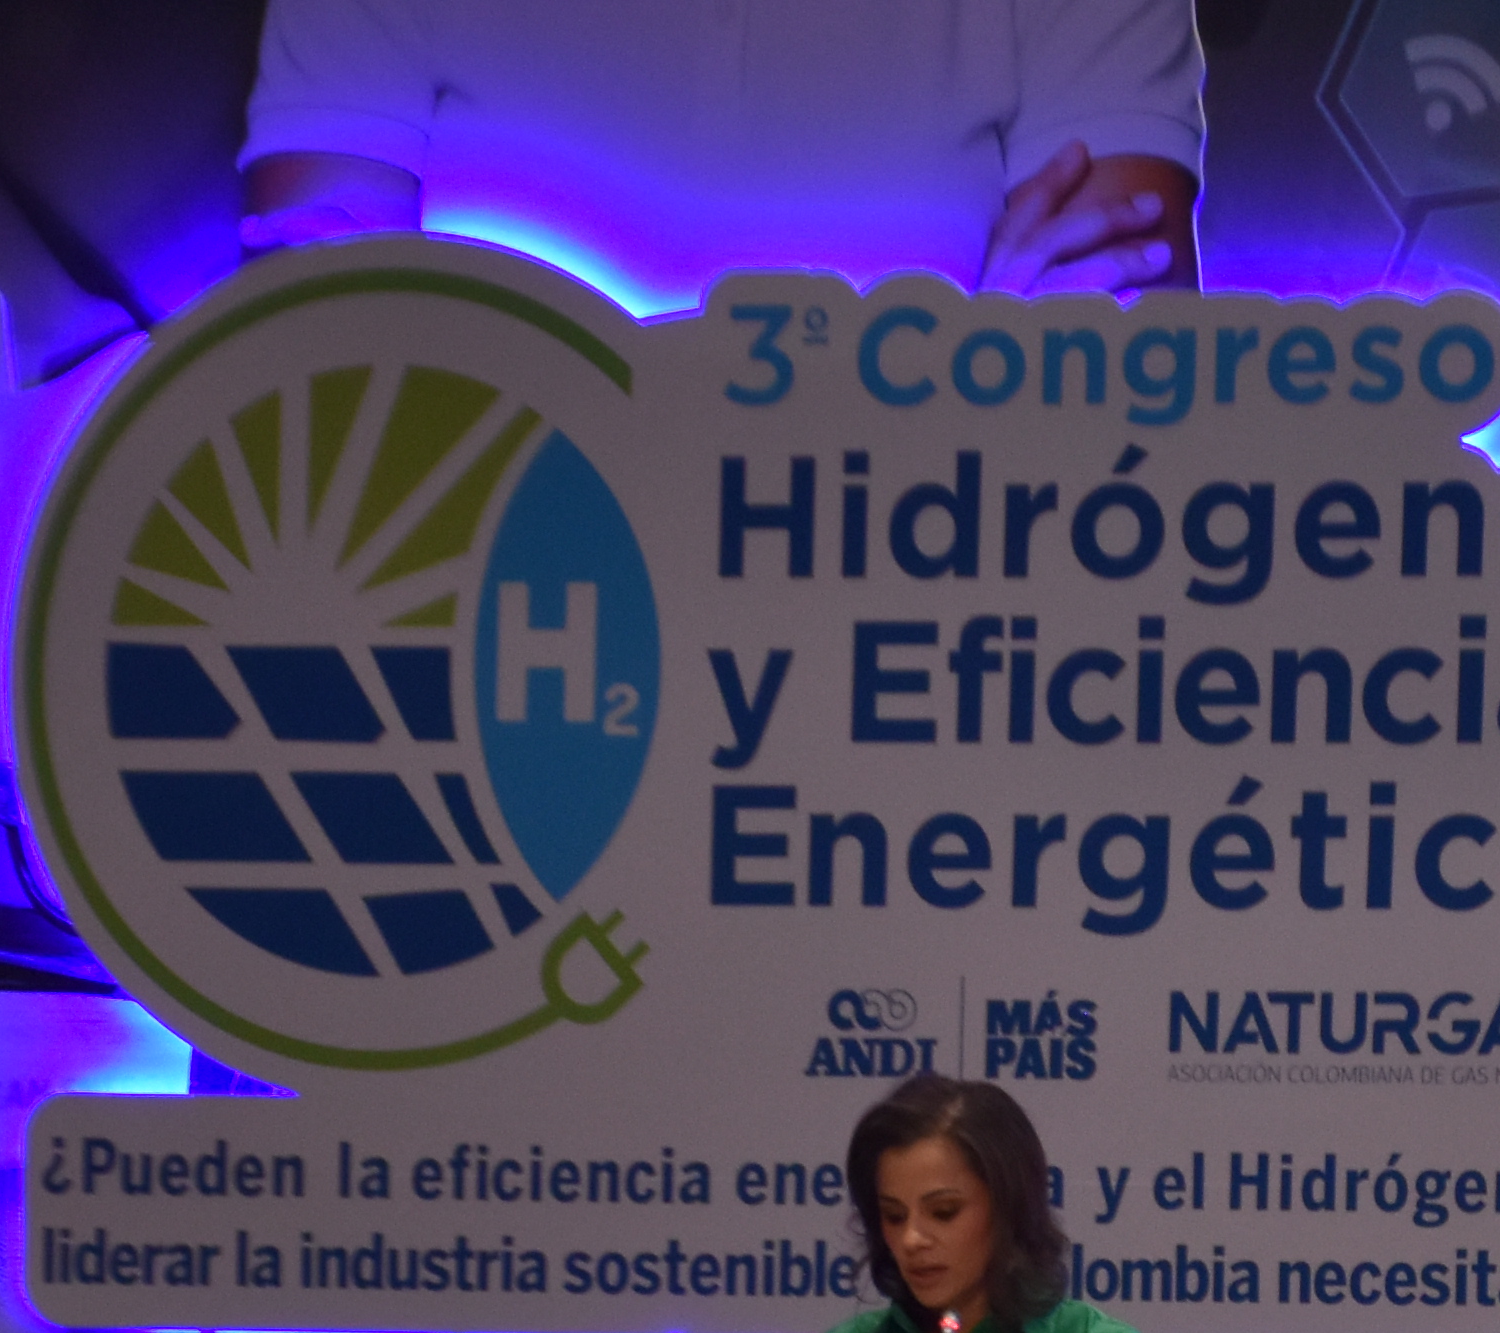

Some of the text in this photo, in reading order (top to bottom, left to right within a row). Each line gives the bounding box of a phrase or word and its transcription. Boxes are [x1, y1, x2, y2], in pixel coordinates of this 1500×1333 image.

[857, 305, 1495, 425] Congreso
[707, 649, 794, 769] y
[985, 990, 1097, 1037] MÁS
[805, 1037, 937, 1077] ANDI
[1167, 1062, 1282, 1084] ASOCIACIÓN
[1287, 1065, 1414, 1085] COLOMBIANA
[1421, 1067, 1443, 1085] DE
[1452, 1067, 1489, 1085] GAS
[42, 1136, 303, 1198] ¿Pueden
[340, 1143, 390, 1199] la
[413, 1144, 711, 1205] eficiencia
[1095, 1166, 1130, 1224] y
[1153, 1152, 1205, 1210] el
[42, 1227, 858, 1298] liderar la industria sostenible
[1071, 1243, 1260, 1304] lombia
